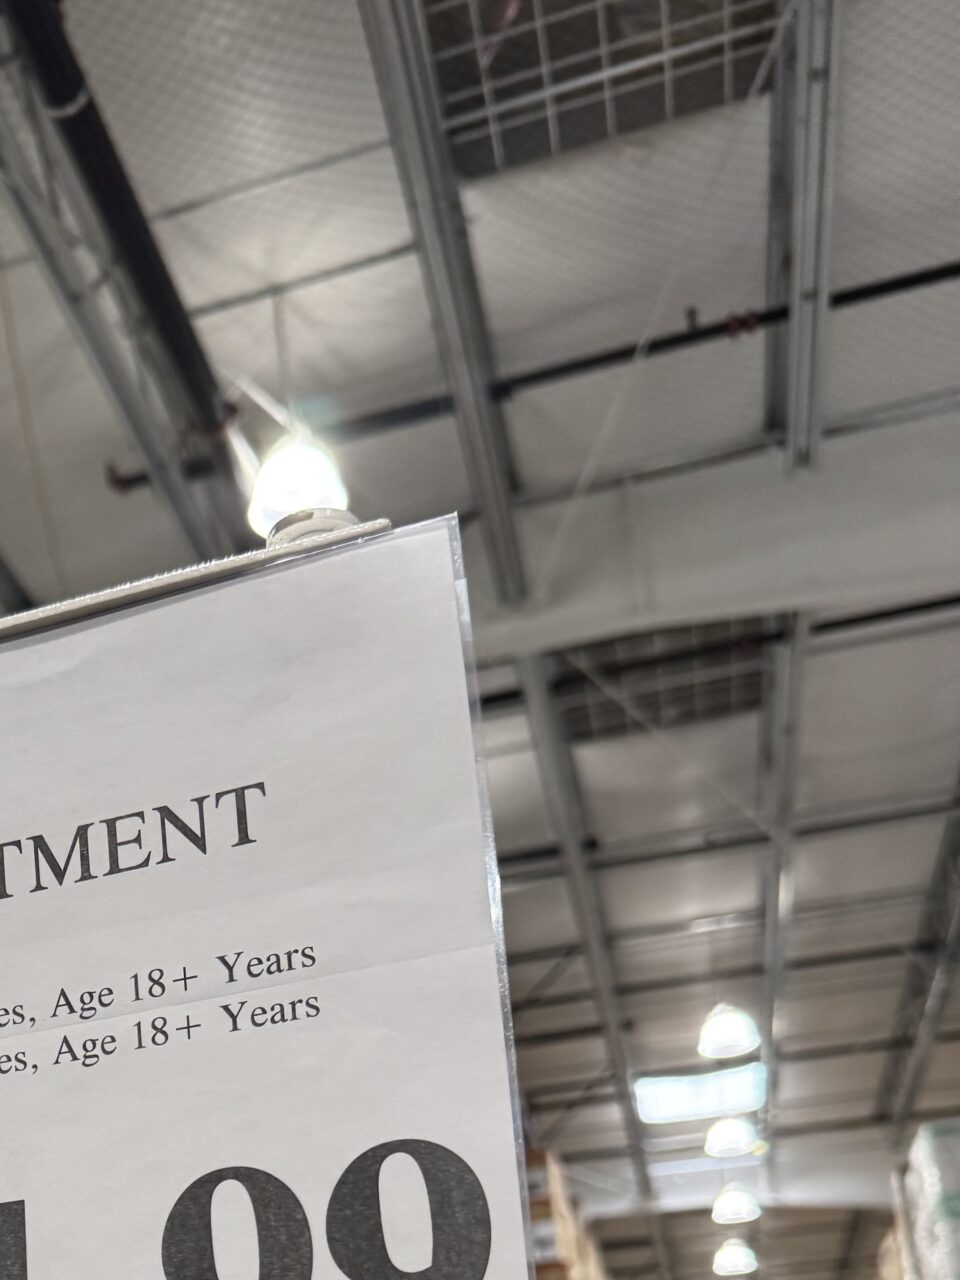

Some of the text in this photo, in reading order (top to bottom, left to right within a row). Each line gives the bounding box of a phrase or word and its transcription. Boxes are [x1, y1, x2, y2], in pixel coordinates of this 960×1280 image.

[50, 987, 115, 1021] Age
[129, 966, 199, 1003] 18+
[215, 945, 317, 984] Years
[52, 1034, 118, 1068] Age
[132, 1014, 202, 1051] 18+
[218, 996, 321, 1033] Years
